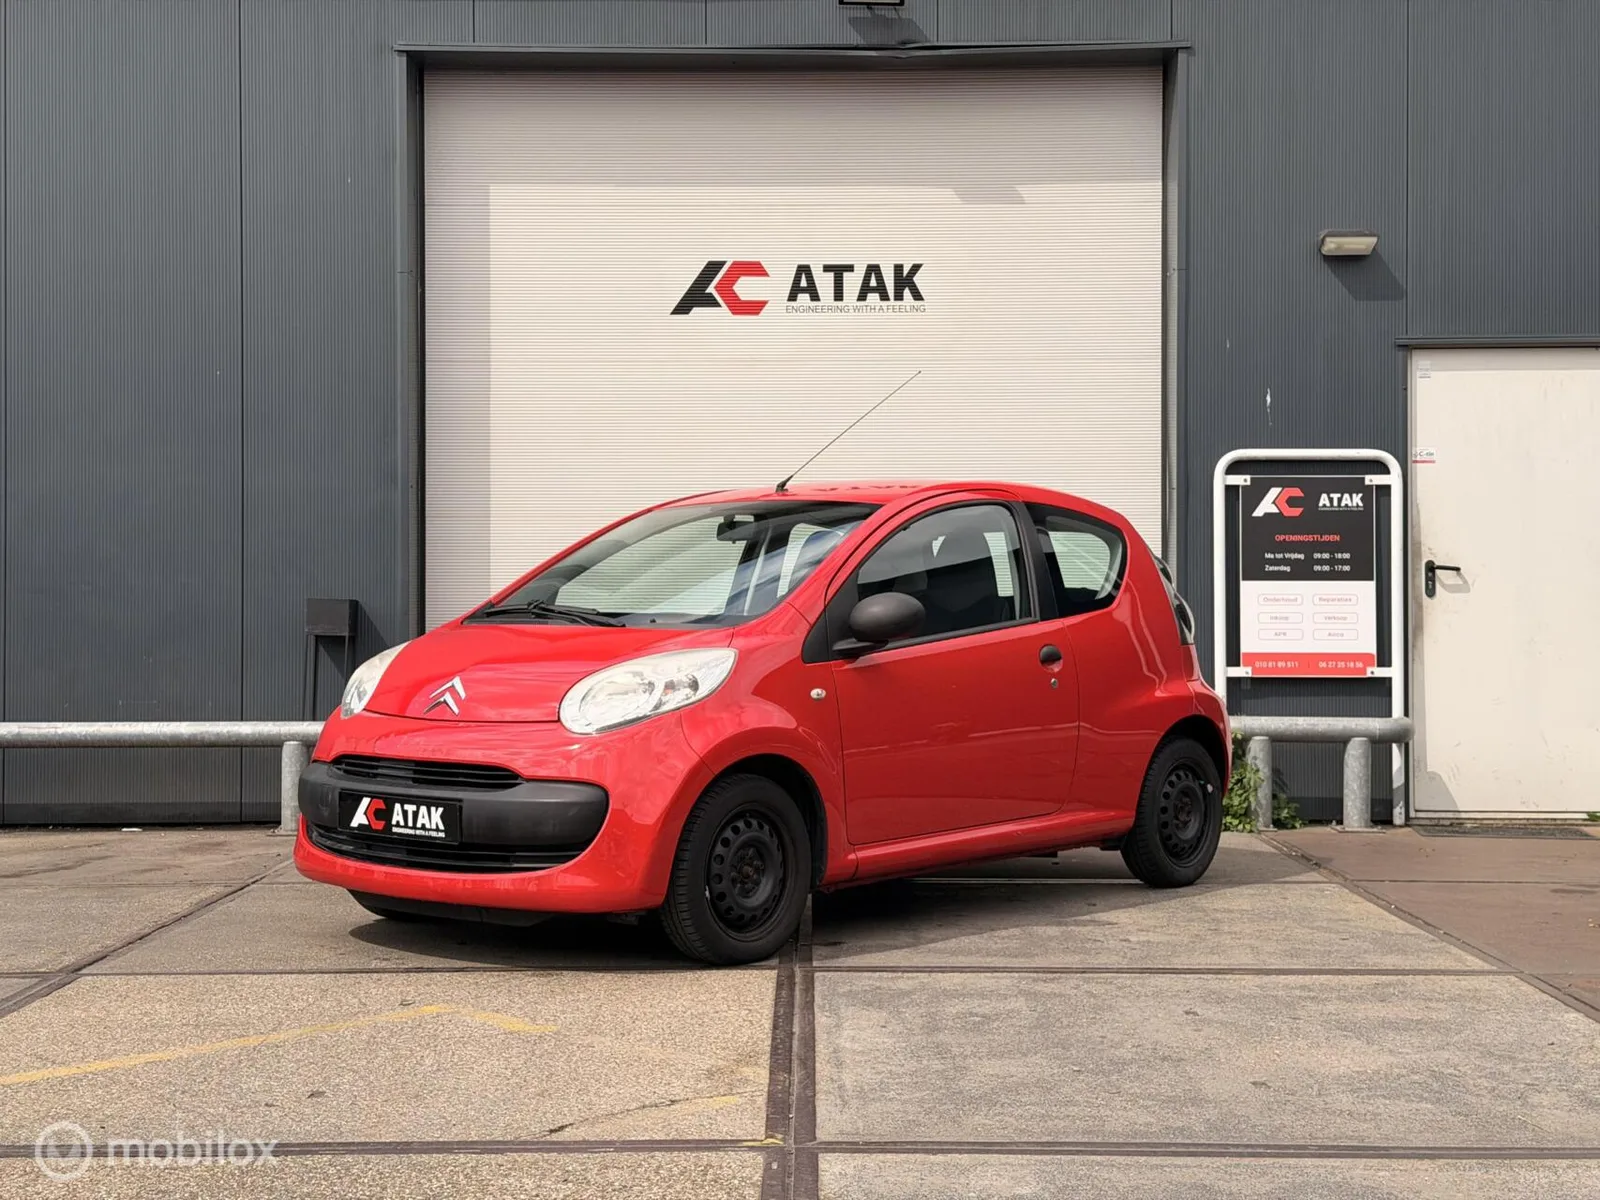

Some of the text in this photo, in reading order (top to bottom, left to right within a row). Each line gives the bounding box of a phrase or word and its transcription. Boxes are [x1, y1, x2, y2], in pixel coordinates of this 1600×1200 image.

[786, 263, 925, 302] ATAK
[785, 304, 926, 314] ENGINEERING WITH A FEELING
[1318, 493, 1364, 508] ATAK
[1274, 534, 1341, 542] OPENINGSTIJDEN
[1284, 552, 1305, 560] Vrijdag
[1264, 564, 1291, 572] Zaterdag
[391, 803, 445, 830] ATAK
